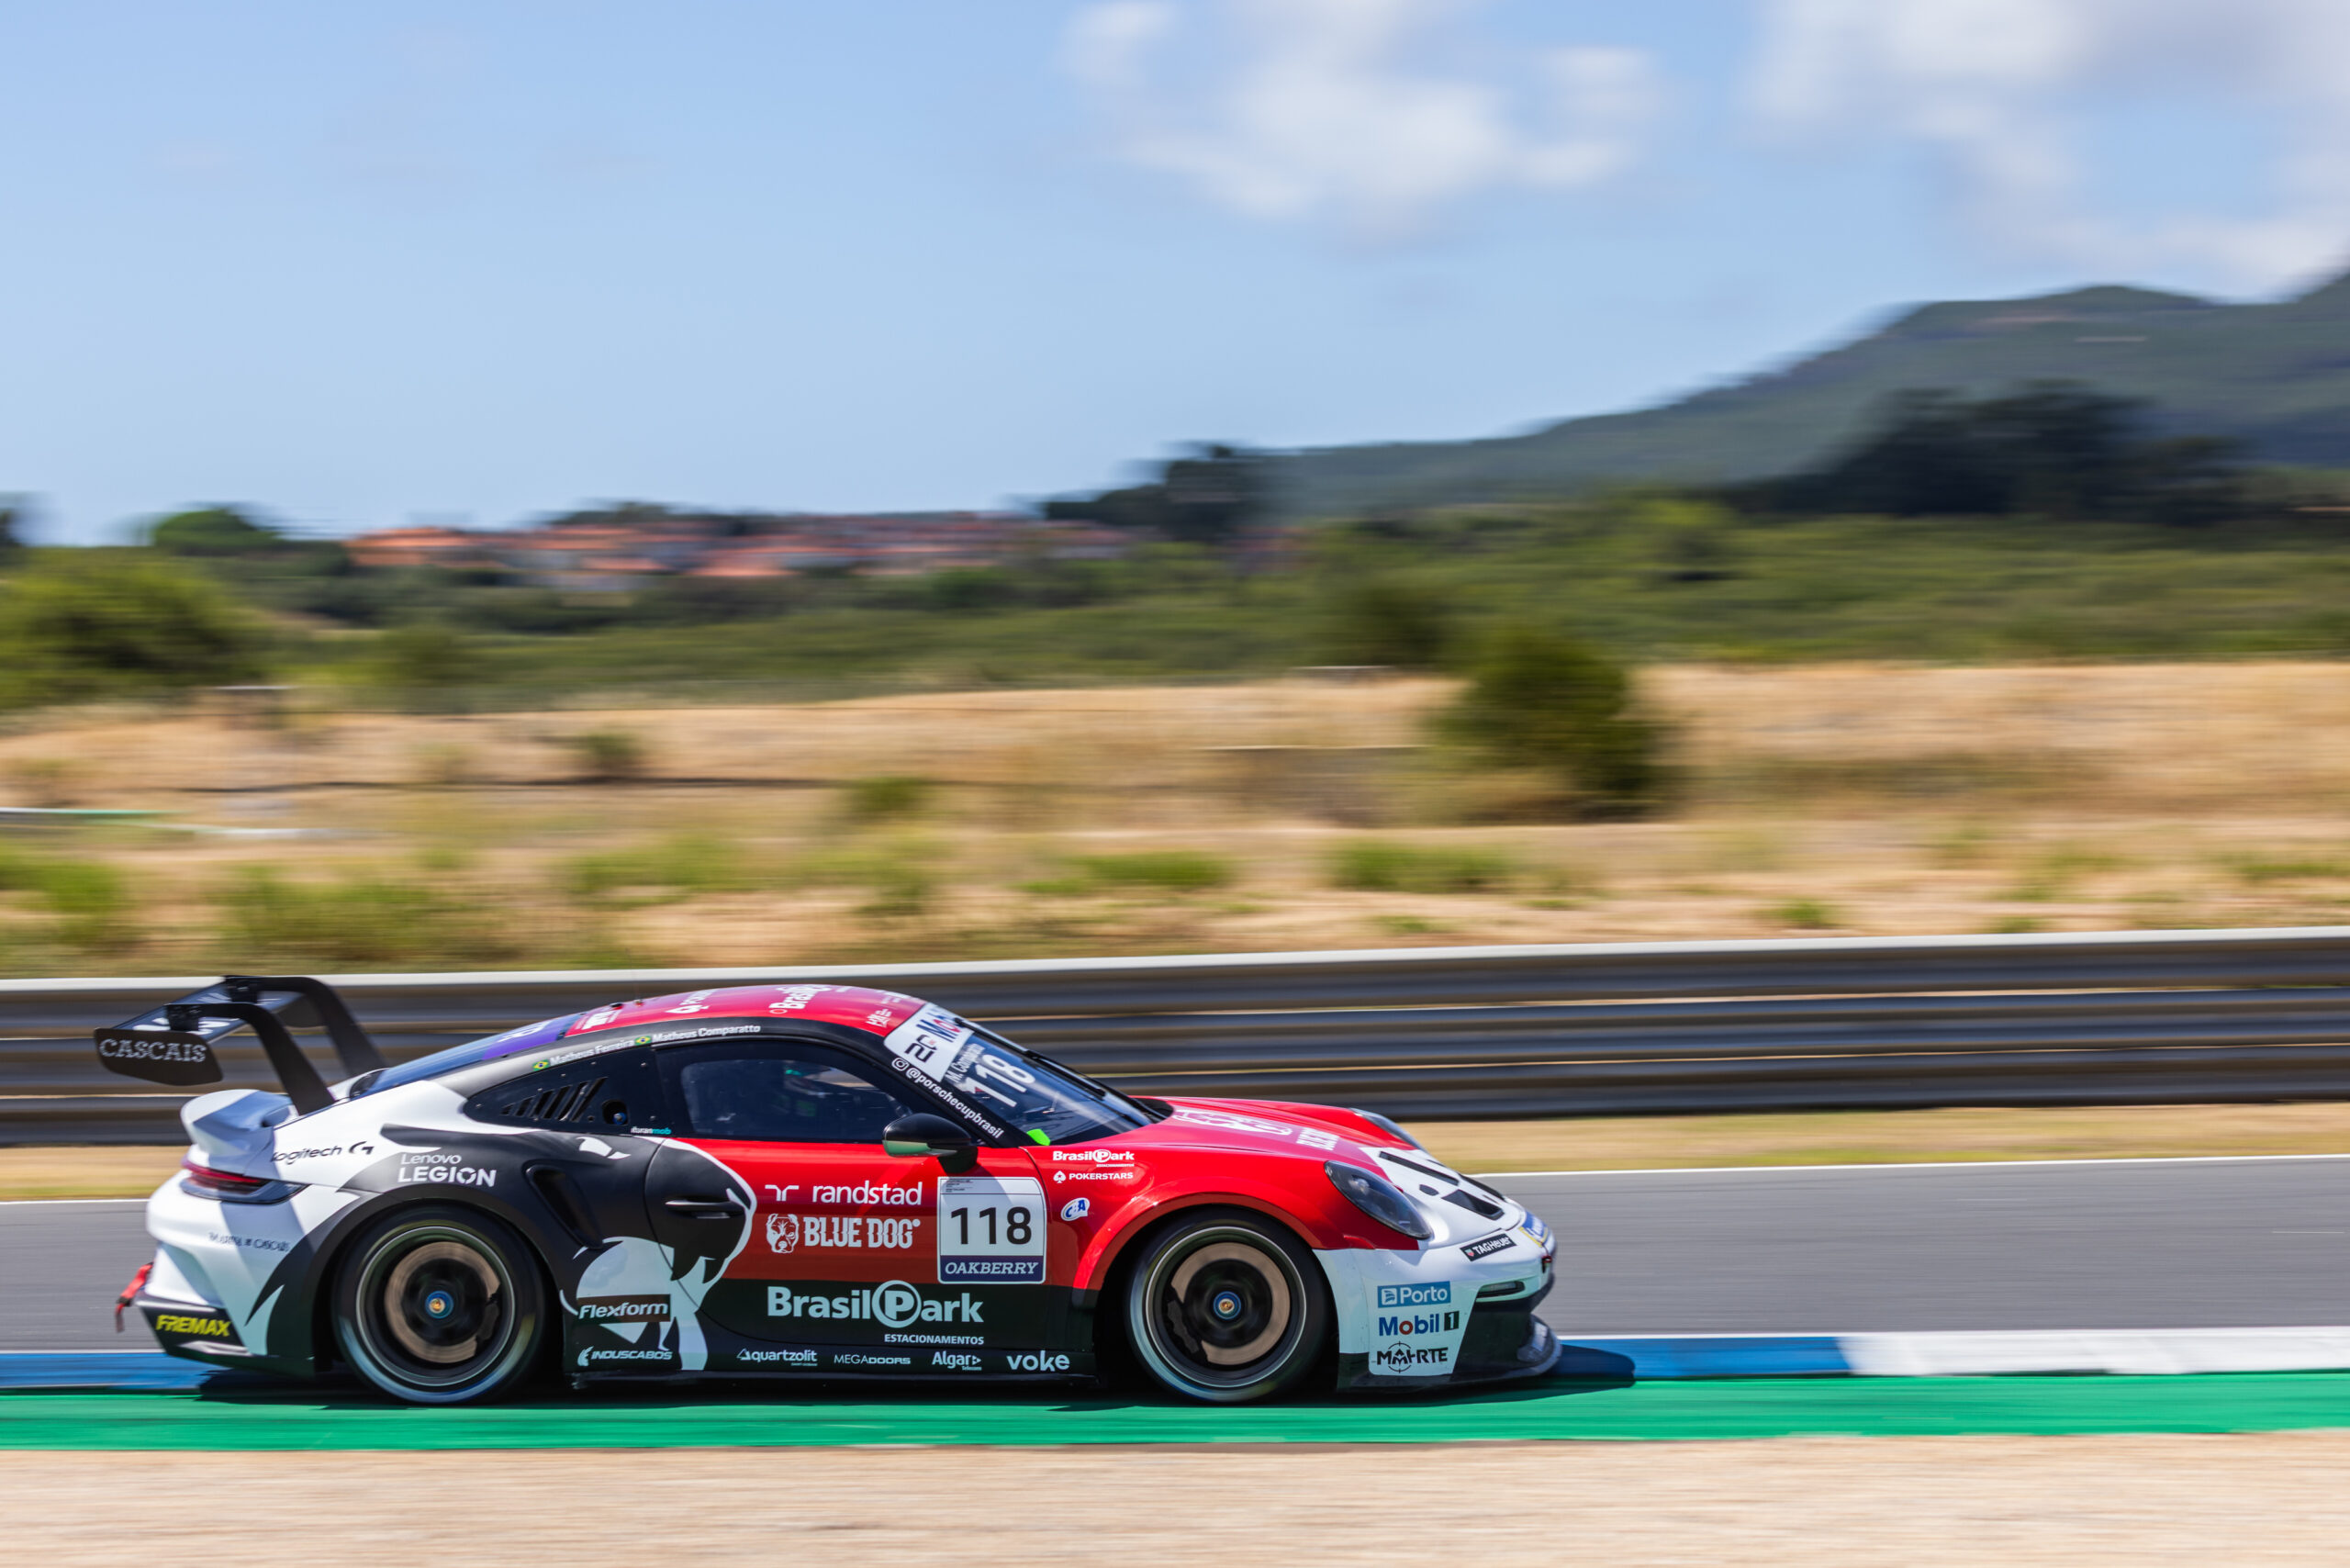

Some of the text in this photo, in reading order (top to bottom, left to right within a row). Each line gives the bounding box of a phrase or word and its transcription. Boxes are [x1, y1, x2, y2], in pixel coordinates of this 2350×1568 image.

[653, 1025, 761, 1043] Matheus Comparatto
[98, 1038, 207, 1063] CASCAIS
[964, 1054, 1035, 1108] 118
[905, 1068, 1004, 1139] @porschecupbrasil
[271, 1146, 342, 1165] logitech
[401, 1154, 462, 1165] Lenovo
[1053, 1149, 1135, 1163] BrasilPark
[397, 1166, 497, 1187] LEGION
[812, 1180, 923, 1205] randstad
[802, 1215, 862, 1248] BLUE
[950, 1207, 1032, 1245] 118
[945, 1261, 1039, 1274] OAKBERRY
[767, 1280, 984, 1328] BrasilPark
[1400, 1286, 1448, 1305] Porto
[578, 1302, 668, 1319] Flexform
[156, 1315, 230, 1337] FREMAX
[1379, 1314, 1439, 1336] Mobil
[884, 1334, 984, 1345] ESTACIONAMENTOS
[591, 1350, 673, 1361] INDUSCABOS
[752, 1350, 817, 1362] quartzolit
[834, 1354, 911, 1364] MEGADOORS
[932, 1350, 971, 1369] Algar
[1006, 1350, 1070, 1372] voke
